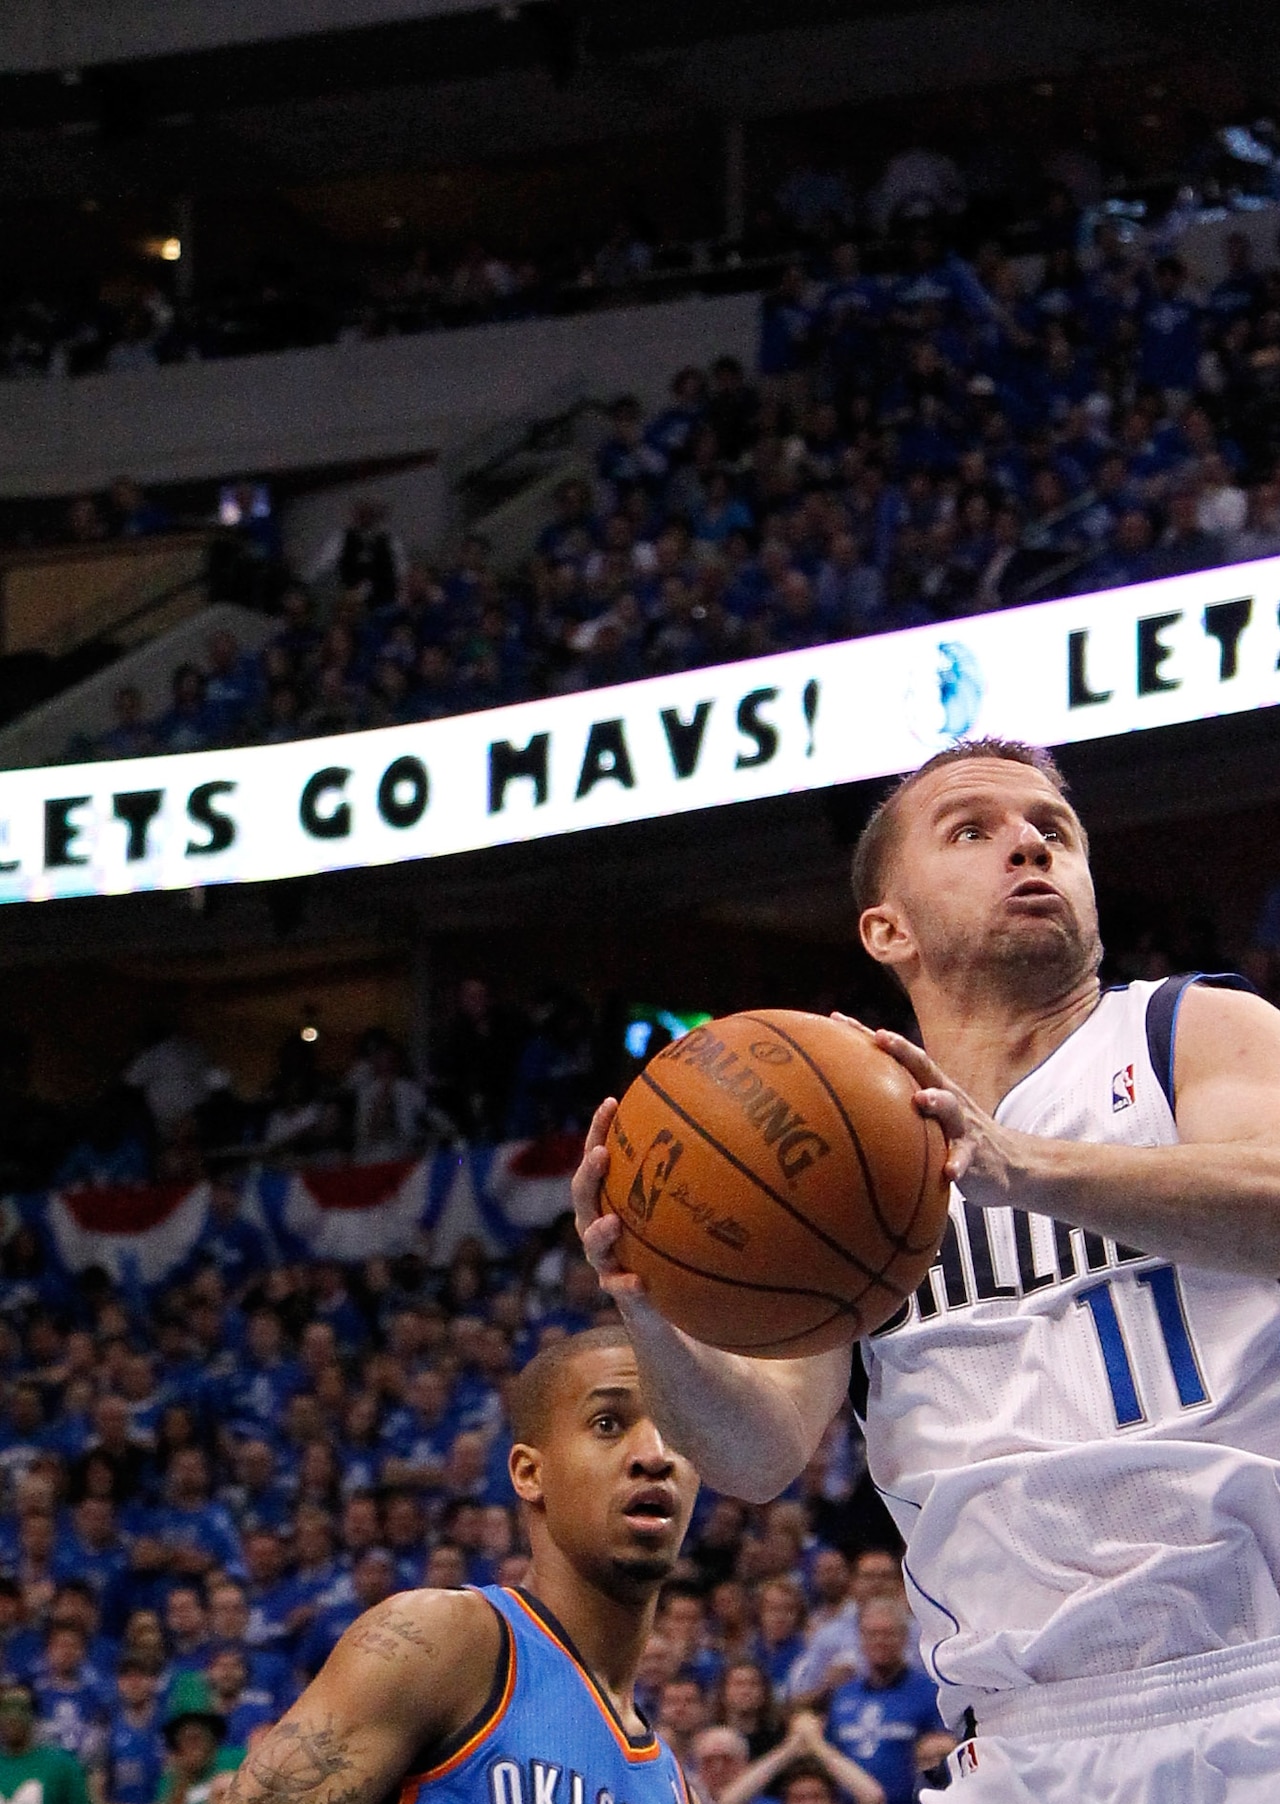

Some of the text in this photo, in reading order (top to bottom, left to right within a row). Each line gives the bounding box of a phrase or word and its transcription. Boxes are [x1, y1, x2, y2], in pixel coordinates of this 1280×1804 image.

[0, 678, 822, 874] ETS GO MAVS!
[1073, 1263, 1214, 1429] 11
